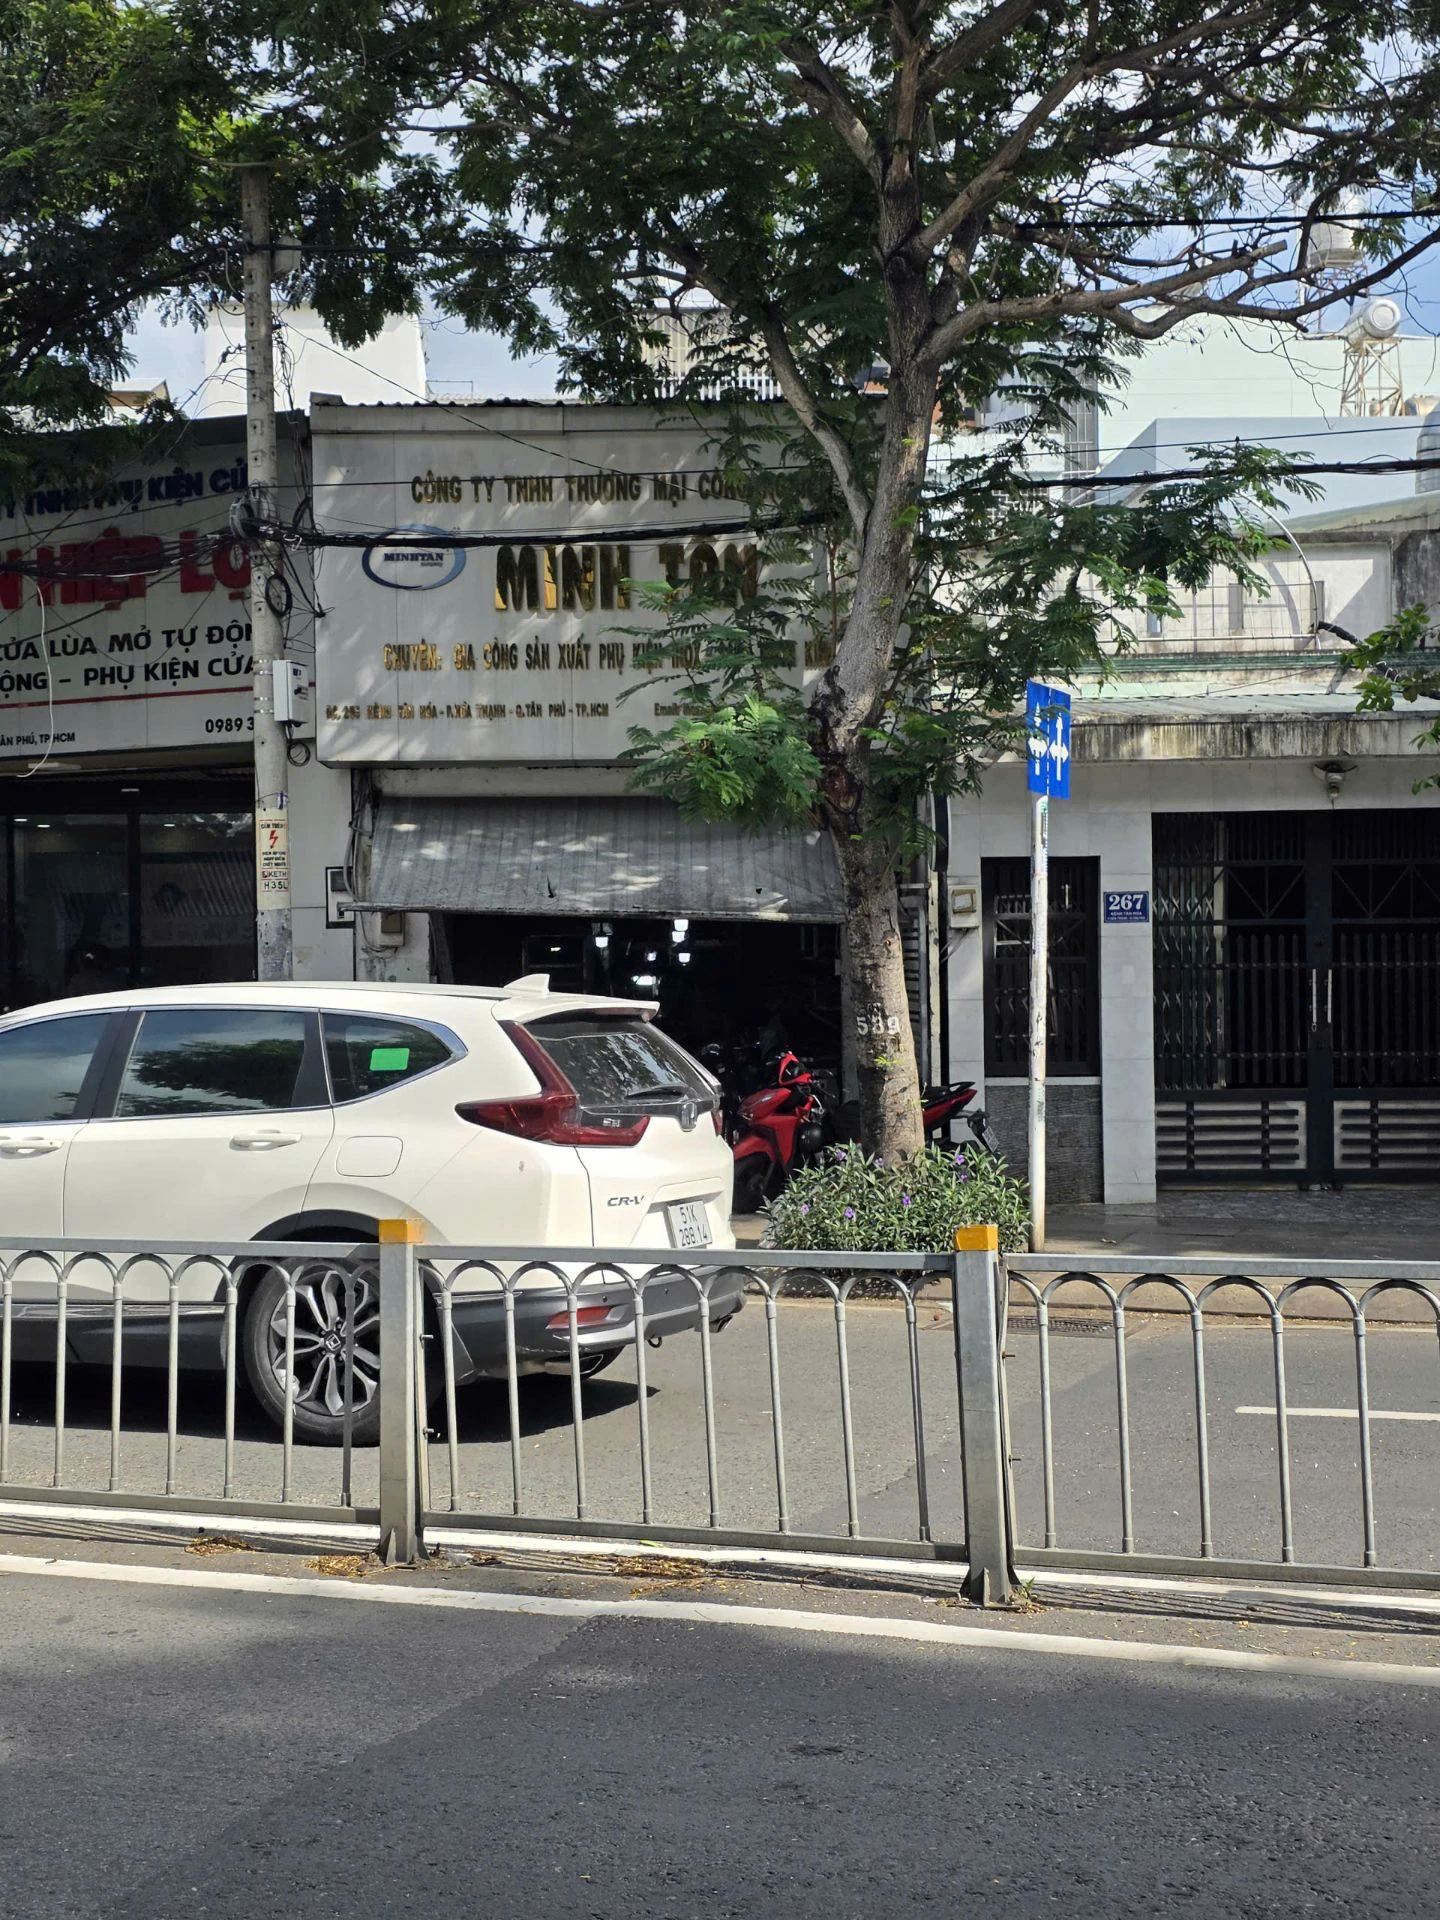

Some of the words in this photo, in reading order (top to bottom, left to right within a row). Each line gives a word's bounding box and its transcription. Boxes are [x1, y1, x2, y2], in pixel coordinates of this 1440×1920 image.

[411, 470, 462, 503] CÔNG
[470, 475, 495, 503] TY
[504, 474, 552, 503] TNHH
[653, 473, 687, 507] MẠI
[495, 544, 630, 612] MINH
[50, 635, 97, 657] LÙA
[108, 625, 152, 653] MỞ
[162, 624, 198, 653] TỰ
[206, 619, 253, 648] ĐỘ
[454, 643, 475, 671] GIA
[599, 641, 625, 675] PHỤ
[0, 670, 47, 699] ỘNG
[84, 667, 134, 690] PHỤ
[144, 658, 200, 686] KIỆN
[0, 734, 14, 746] ÂN
[205, 717, 243, 733] 0989
[1108, 894, 1144, 910] 267
[607, 1195, 645, 1207] CR-V
